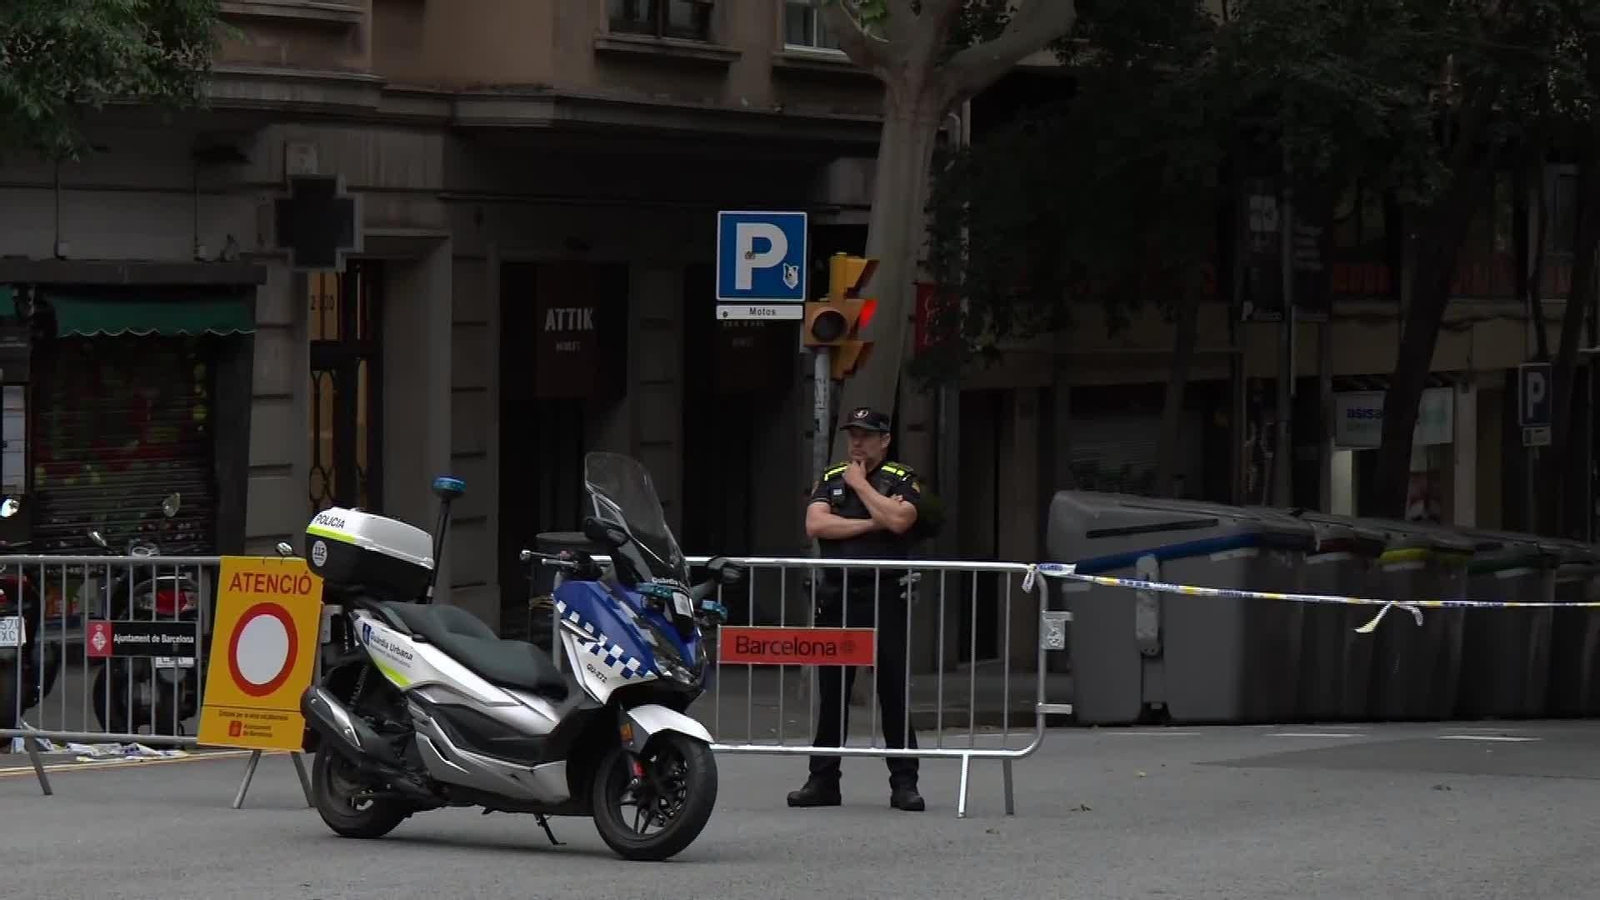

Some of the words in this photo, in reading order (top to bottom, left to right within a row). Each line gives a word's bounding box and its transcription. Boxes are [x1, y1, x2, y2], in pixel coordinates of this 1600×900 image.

[735, 222, 788, 290] P
[544, 307, 594, 332] ATTIK
[749, 307, 776, 316] Motos
[1527, 371, 1546, 419] P
[315, 513, 345, 529] POLICIA
[314, 546, 325, 556] 112
[228, 571, 312, 595] ATENCIÓ
[113, 633, 150, 645] Ajuntament
[151, 634, 160, 643] de
[161, 634, 194, 644] Barcelona
[735, 635, 837, 656] Barcelona
